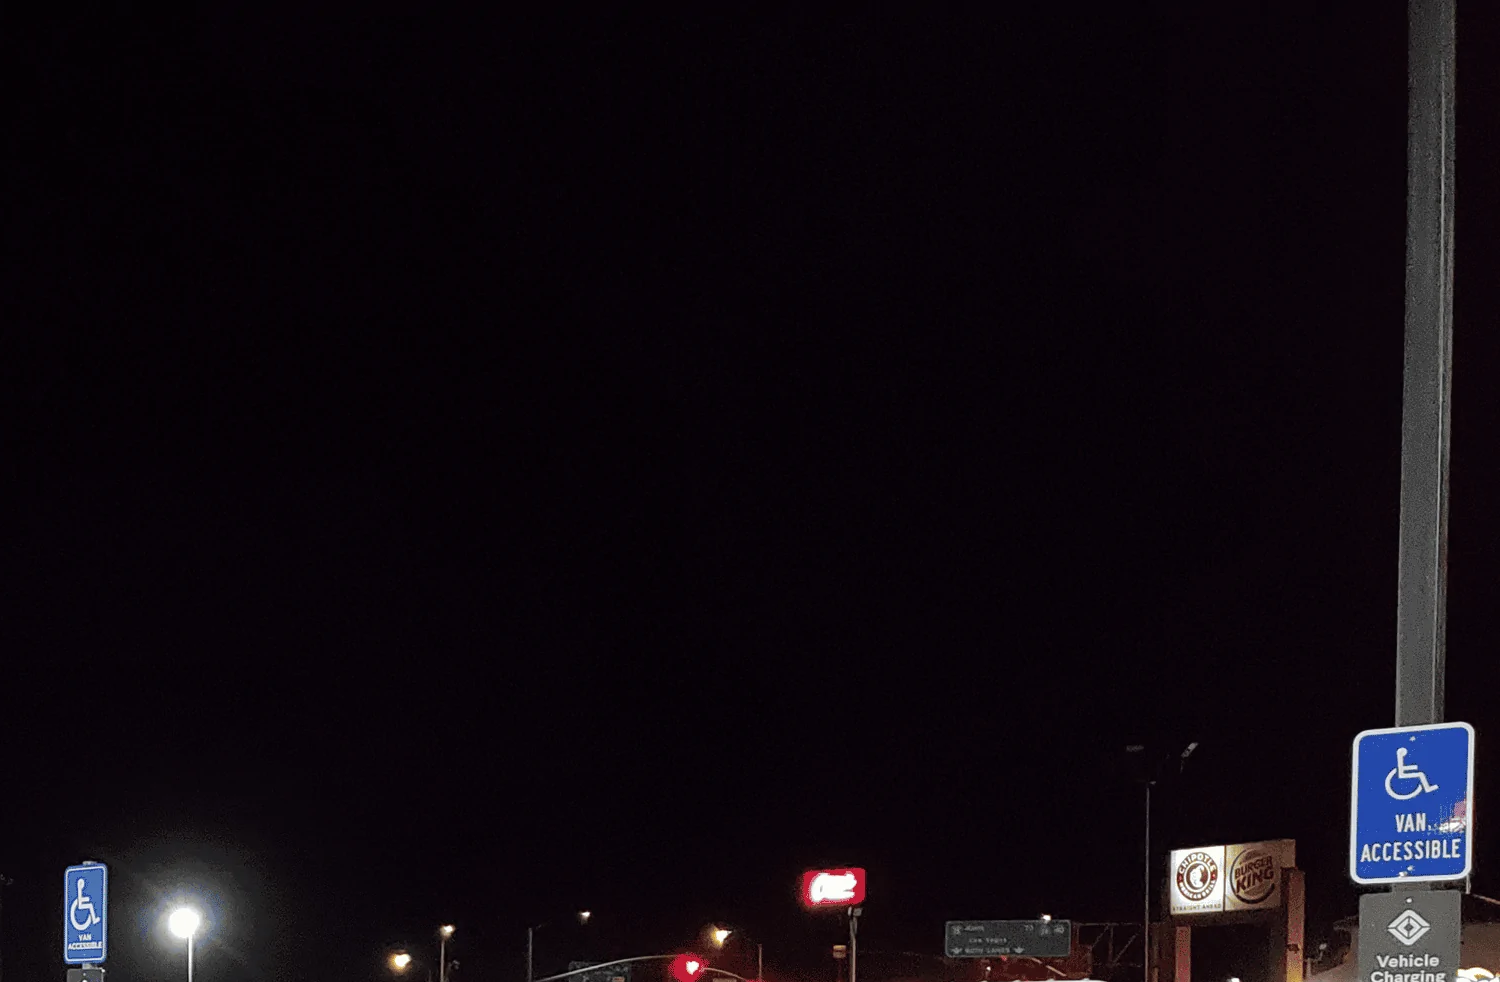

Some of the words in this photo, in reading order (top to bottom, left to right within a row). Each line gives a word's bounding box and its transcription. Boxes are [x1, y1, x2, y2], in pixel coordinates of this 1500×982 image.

[1395, 812, 1427, 833] VAN
[1360, 838, 1462, 863] ACCESSIBLE
[1178, 852, 1217, 875] CHIPOTLE
[1234, 855, 1274, 880] BURGER
[1236, 866, 1274, 893] KING
[67, 941, 103, 950] ACCESSIBLE
[78, 933, 92, 942] VAN
[1376, 953, 1440, 968] Vehicle
